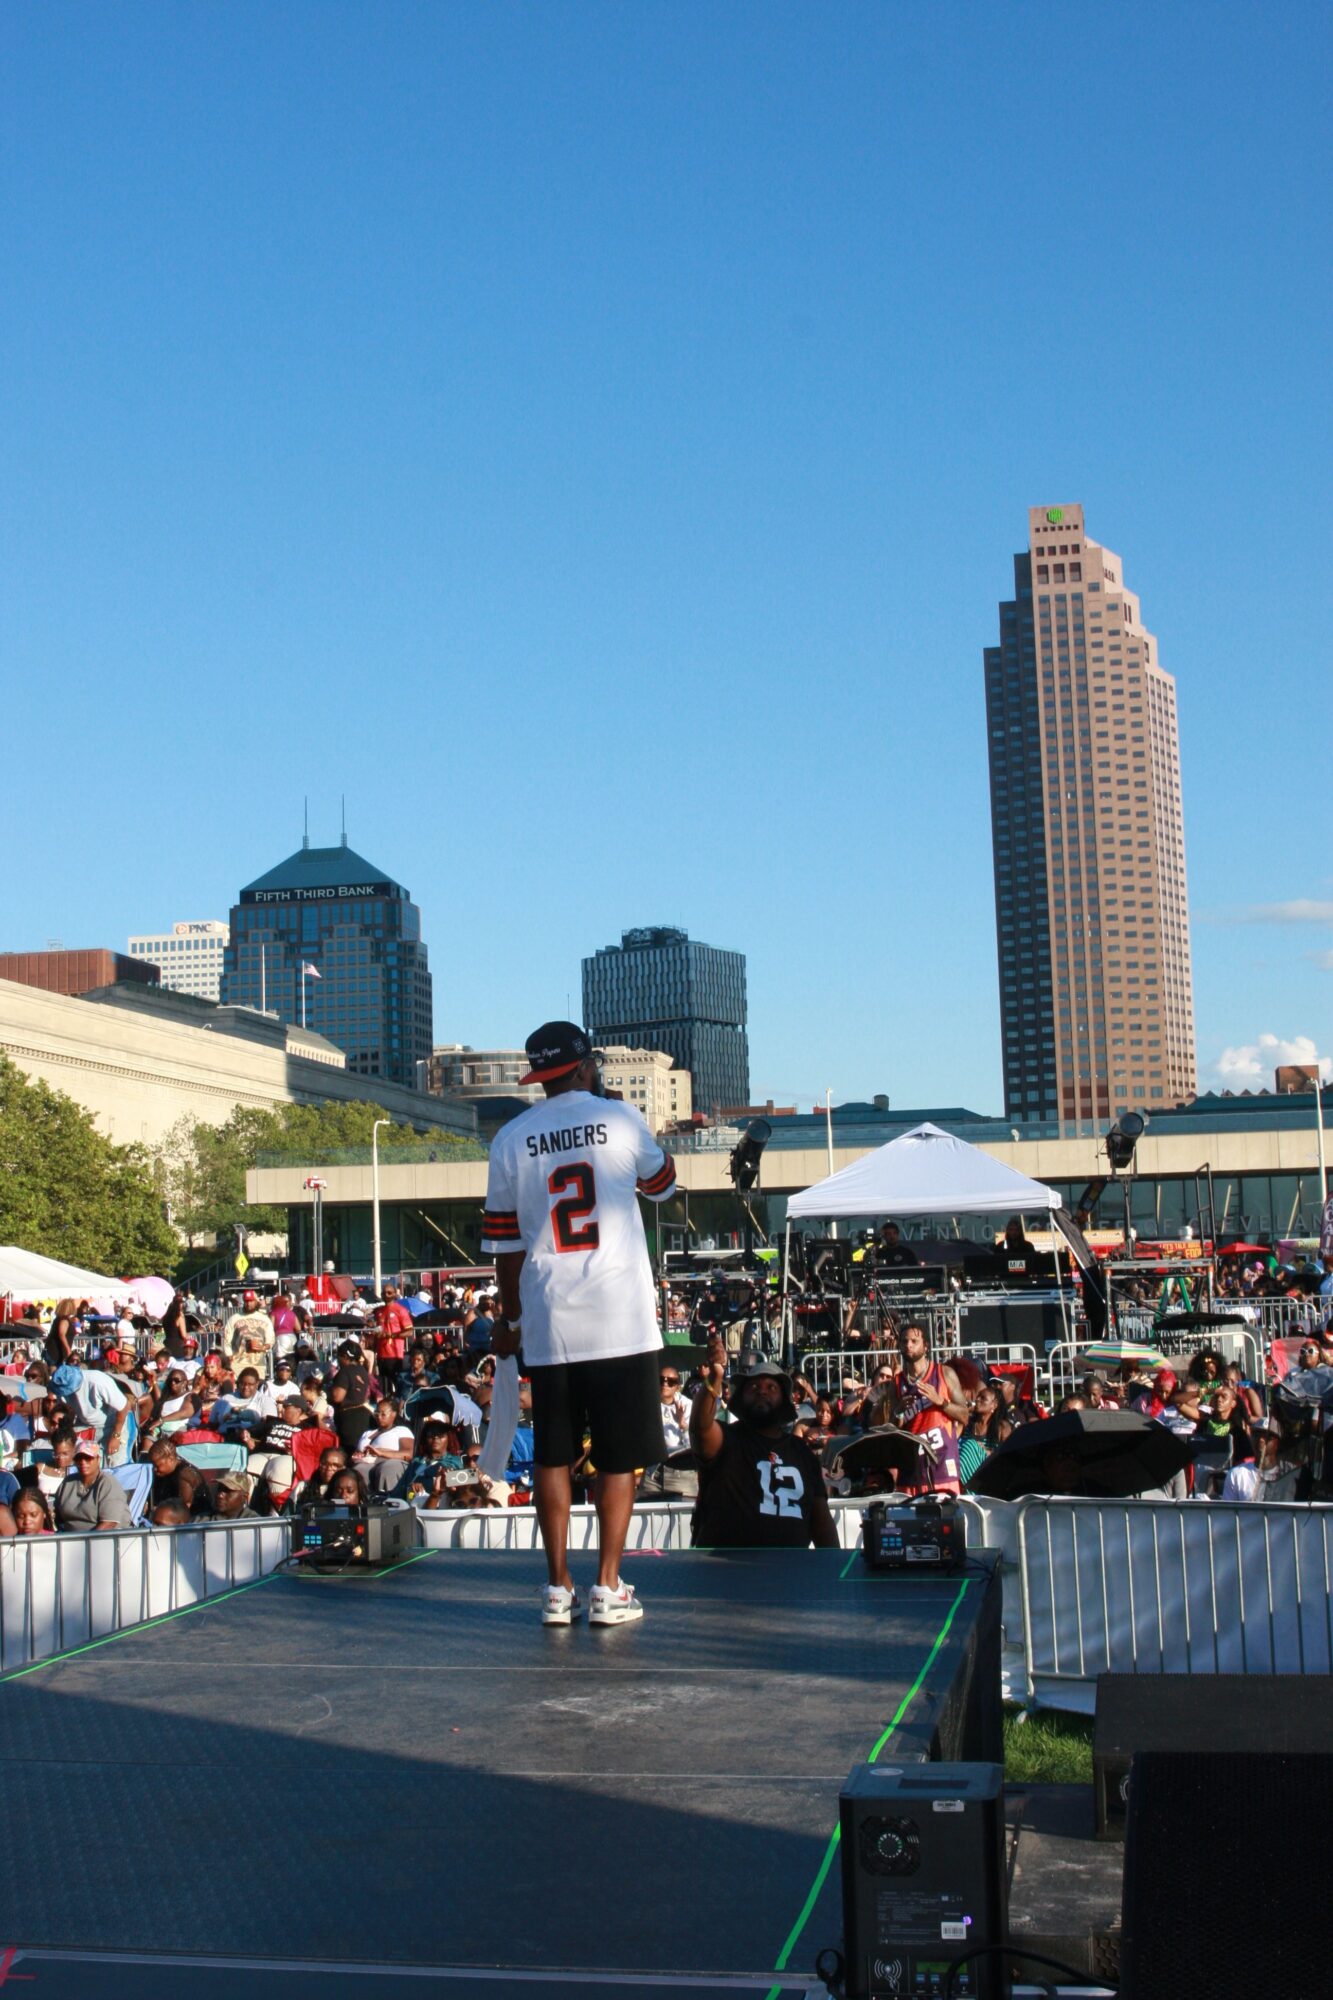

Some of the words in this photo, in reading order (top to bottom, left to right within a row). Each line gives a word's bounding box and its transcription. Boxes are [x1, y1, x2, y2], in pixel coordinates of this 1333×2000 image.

[188, 923, 212, 934] PNC
[526, 1123, 608, 1157] SANDERS
[547, 1161, 600, 1255] 2
[756, 1460, 805, 1520] 12
